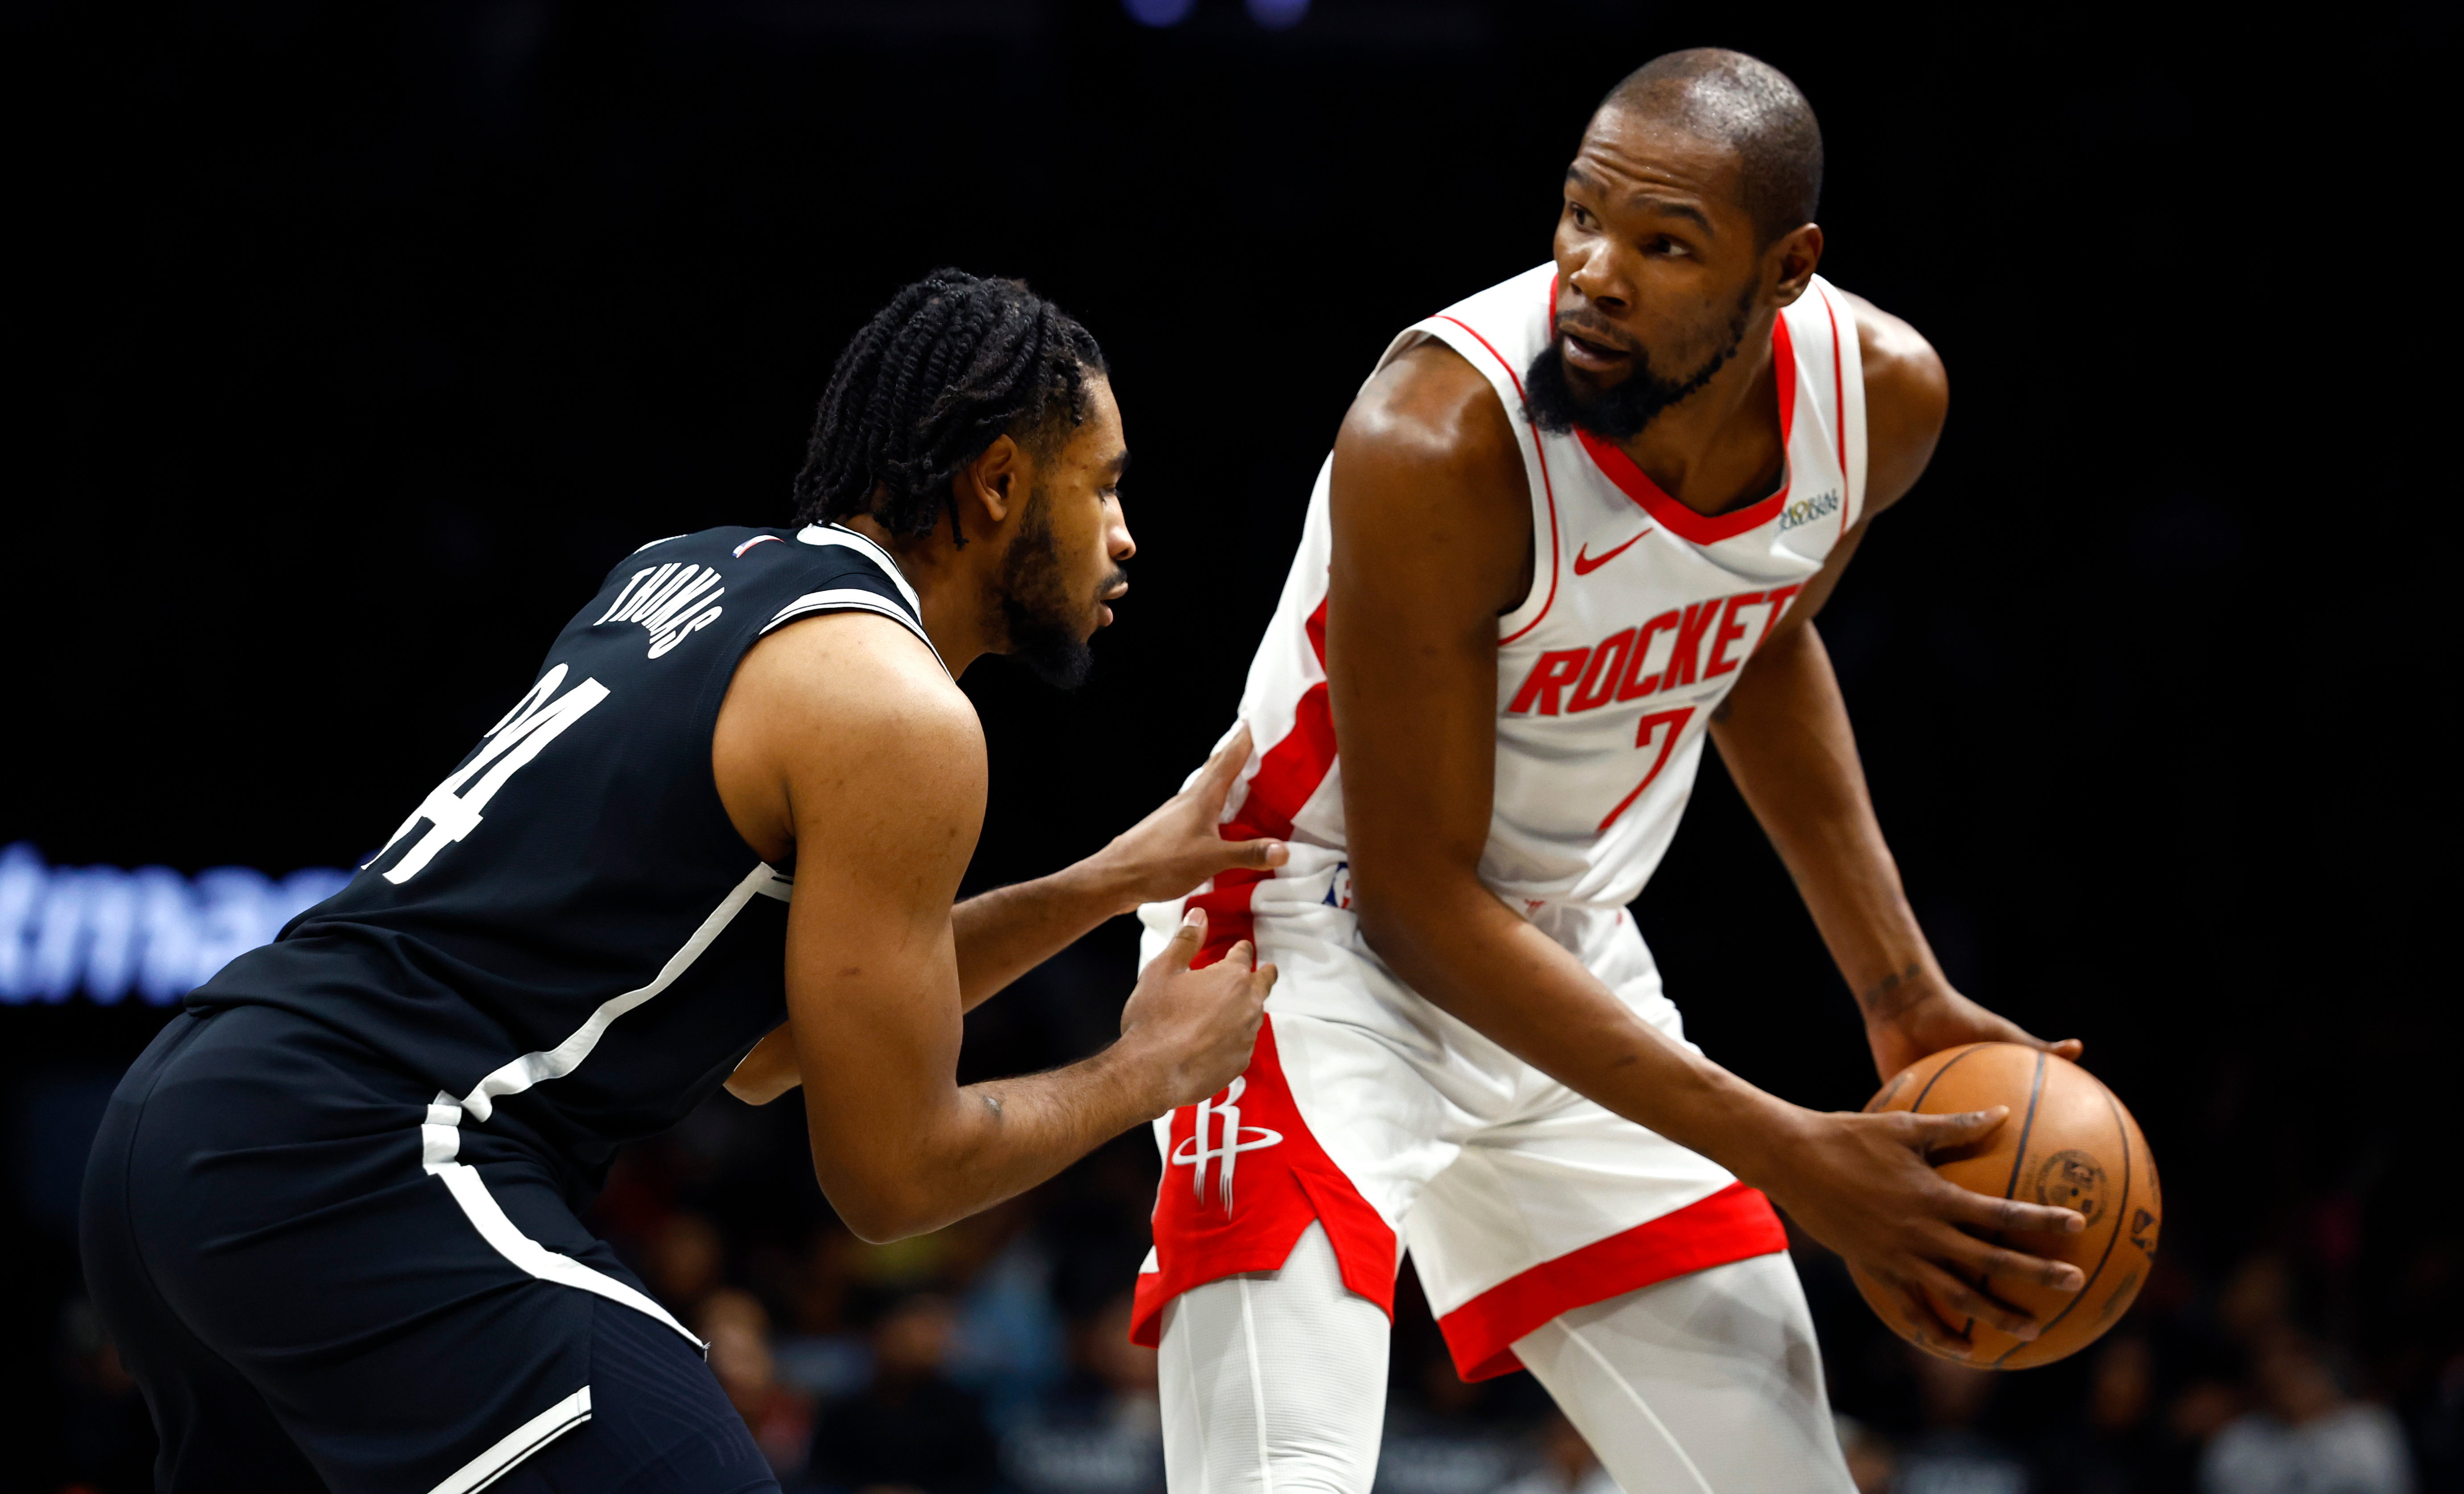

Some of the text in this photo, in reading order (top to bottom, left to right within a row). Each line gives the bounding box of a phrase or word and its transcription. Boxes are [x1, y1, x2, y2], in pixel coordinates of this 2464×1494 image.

[593, 562, 723, 659] THOMAS
[1508, 583, 1806, 716] ROCKET
[1595, 706, 1697, 839] 7
